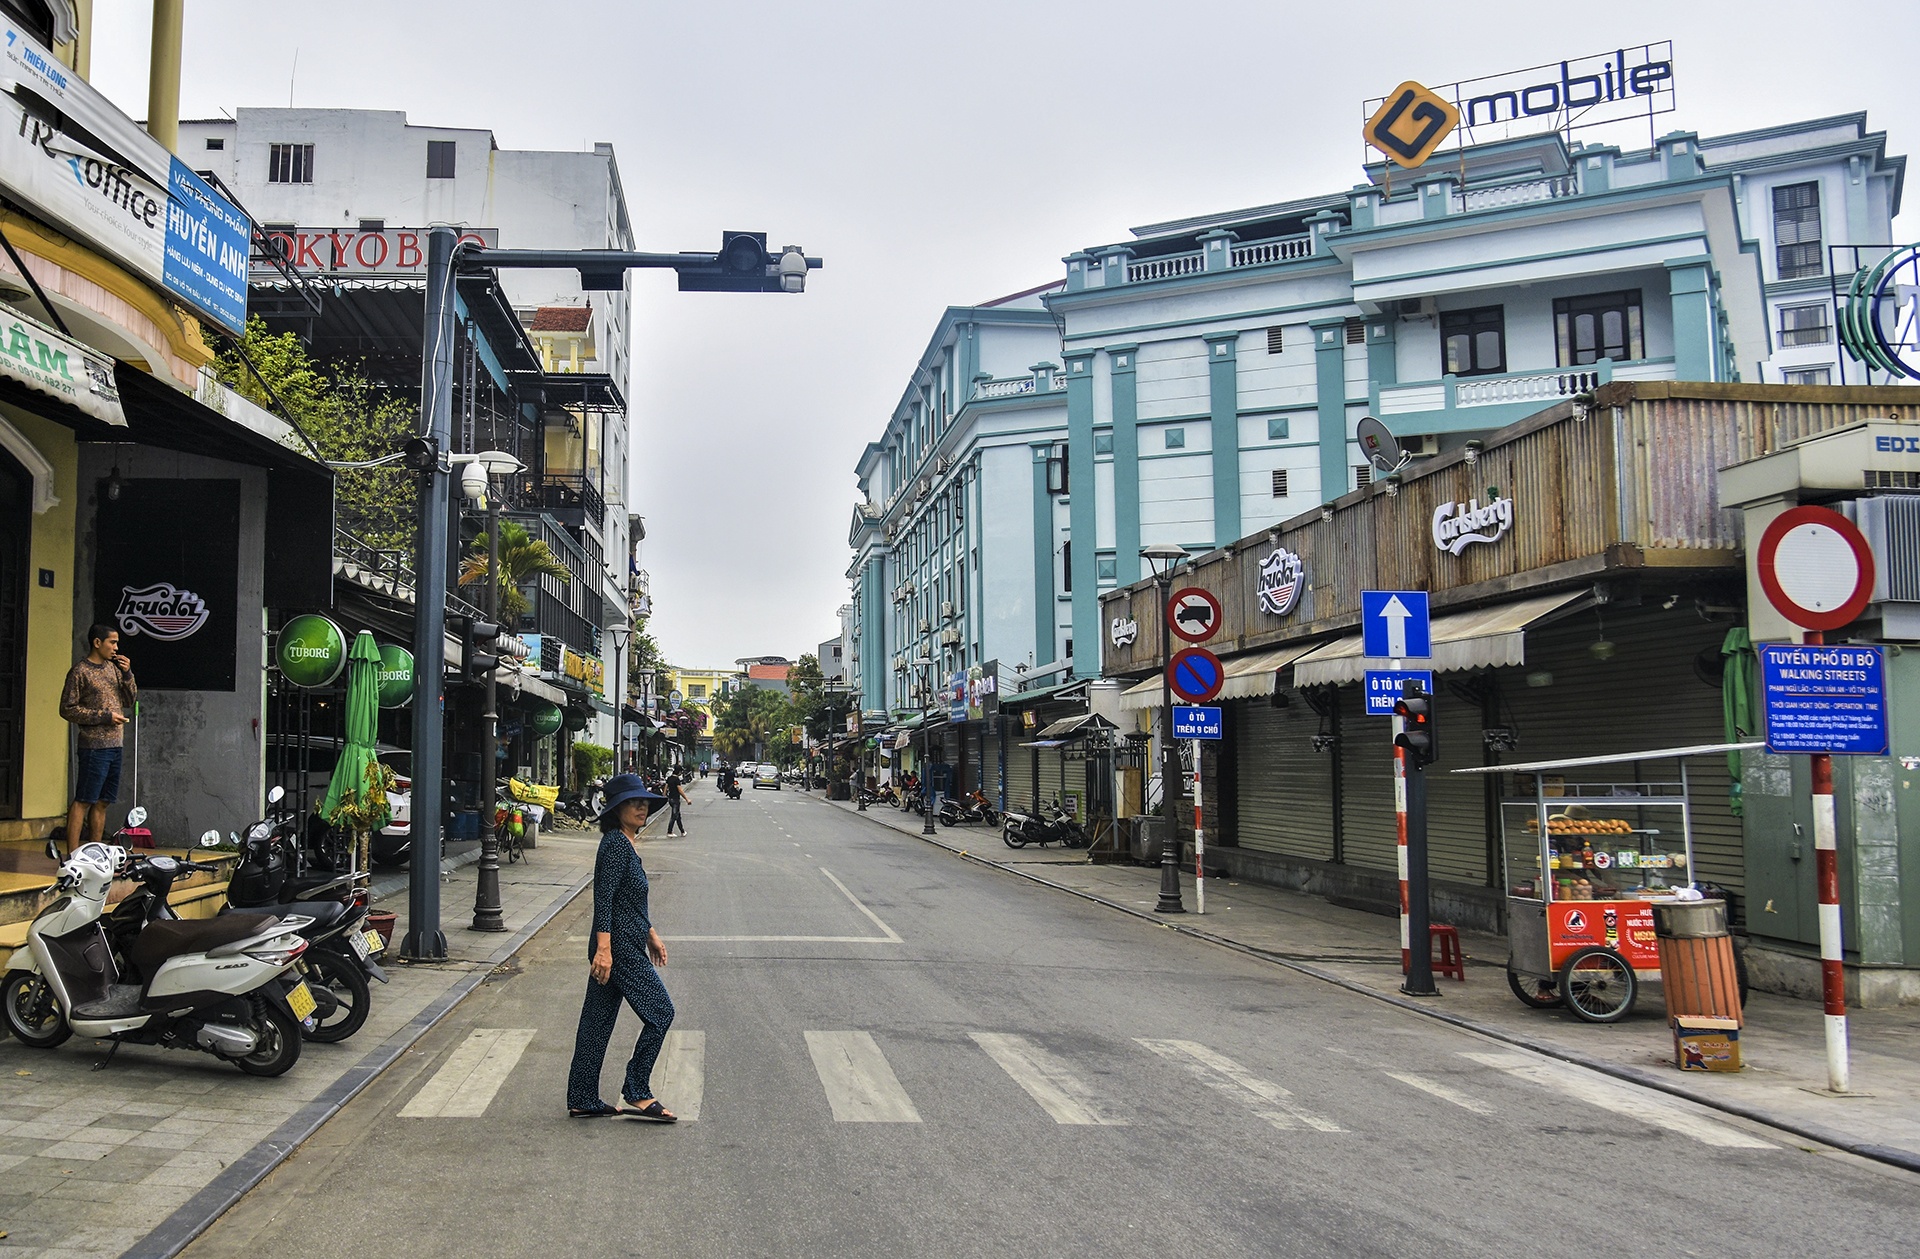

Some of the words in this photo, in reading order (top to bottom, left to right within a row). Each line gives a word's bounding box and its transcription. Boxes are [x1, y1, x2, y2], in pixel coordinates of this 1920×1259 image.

[46, 65, 67, 90] LONG
[1467, 48, 1671, 127] mobile
[168, 202, 218, 262] HUYỀN
[219, 240, 247, 283] ANH
[1431, 496, 1513, 554] Carlsberg
[290, 646, 330, 659] TUBORG
[1768, 648, 1810, 666] TUYẾN
[1812, 648, 1840, 667] PHỐ
[1841, 653, 1855, 667] ĐI
[1856, 650, 1875, 669] BỘ
[1779, 668, 1823, 681] WALKING
[1824, 669, 1867, 682] STREETS
[1371, 676, 1380, 691] Ô
[1380, 676, 1393, 691] TÔ
[1370, 694, 1395, 708] TRÊN
[1188, 711, 1195, 722] Ô
[1195, 711, 1206, 722] TÔ
[1176, 723, 1196, 734] TRÊN
[1196, 724, 1202, 734] 9
[215, 962, 250, 971] LEAD
